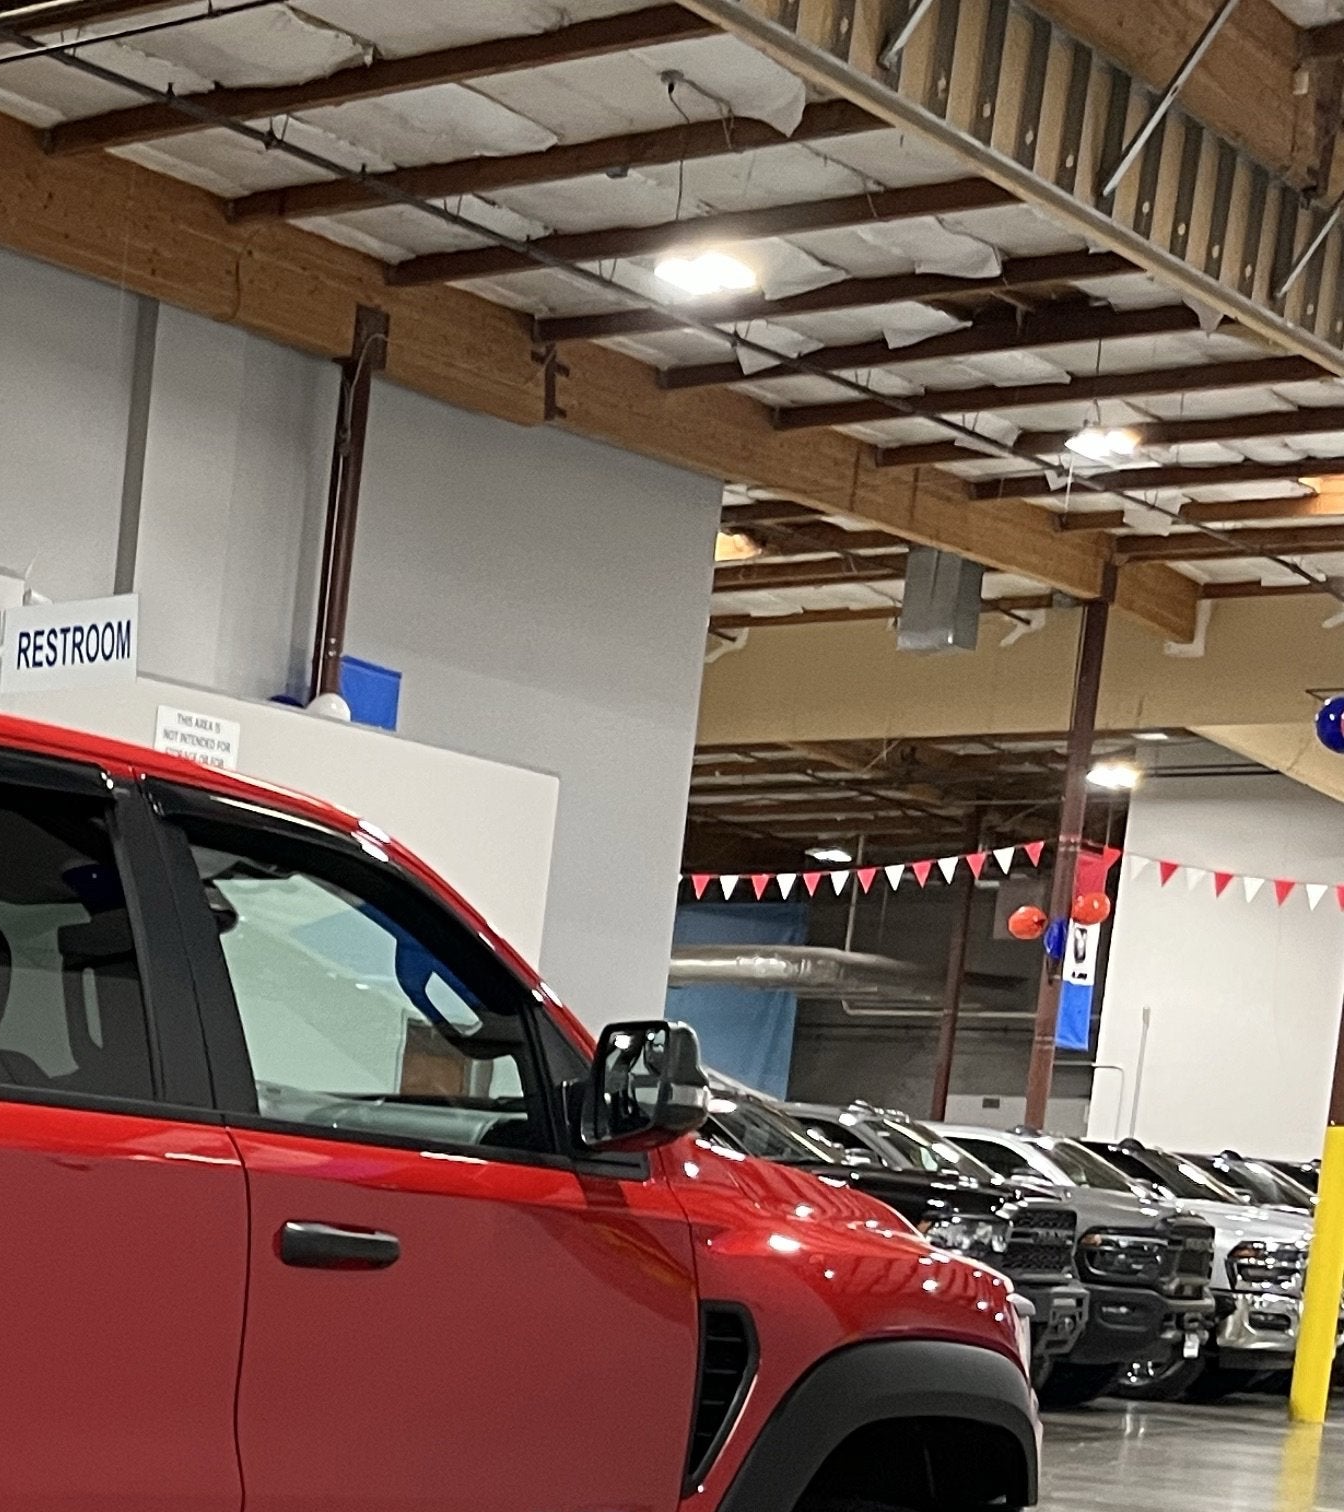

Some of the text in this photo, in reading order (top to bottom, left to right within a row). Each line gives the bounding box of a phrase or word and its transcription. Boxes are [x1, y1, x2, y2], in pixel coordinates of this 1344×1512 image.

[17, 619, 131, 670] RESTROOM
[177, 713, 193, 727] THIS
[195, 717, 213, 731] AREA
[163, 728, 231, 752] NOT INTENDED FOR
